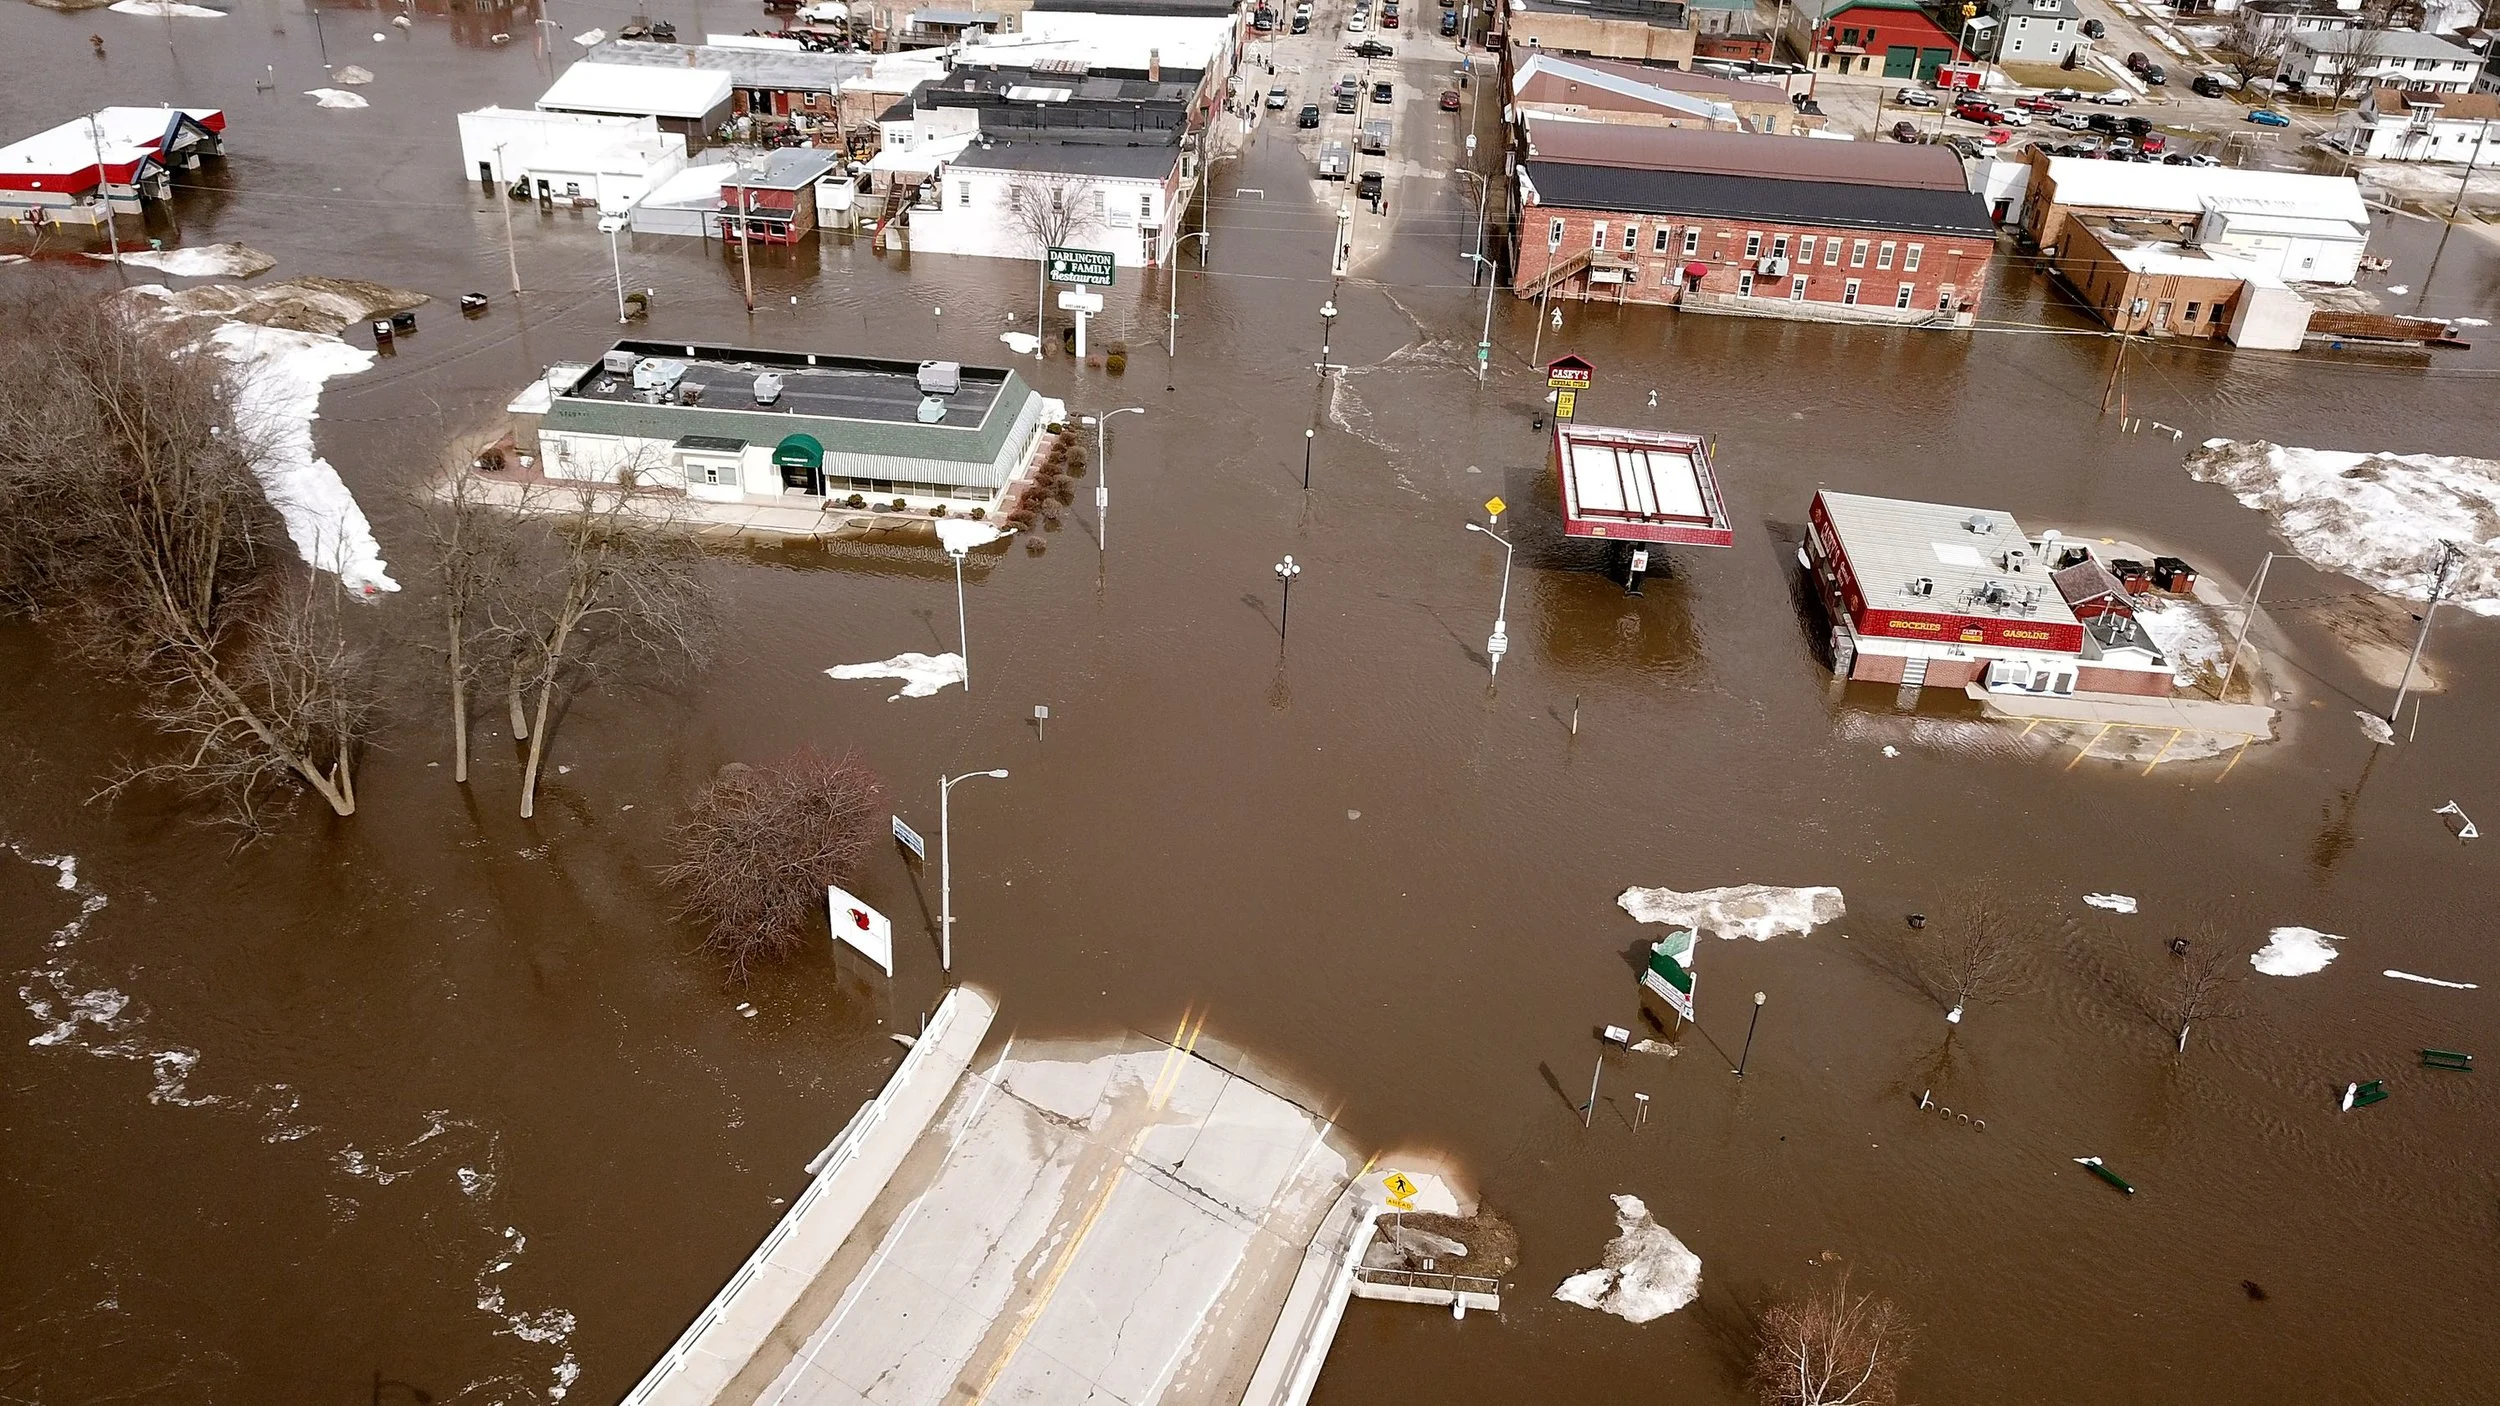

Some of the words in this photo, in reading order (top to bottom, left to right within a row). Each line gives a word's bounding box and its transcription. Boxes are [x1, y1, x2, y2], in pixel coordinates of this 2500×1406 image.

[1050, 251, 1111, 265] DARLINGTON
[1071, 263, 1111, 275] FAMILY
[1050, 269, 1111, 285] Restaurant
[1552, 369, 1589, 380] CASEY'S
[1889, 620, 1942, 632] GROCERIES
[2002, 629, 2050, 640] GASOLINE
[1388, 1199, 1412, 1209] AHEAD
